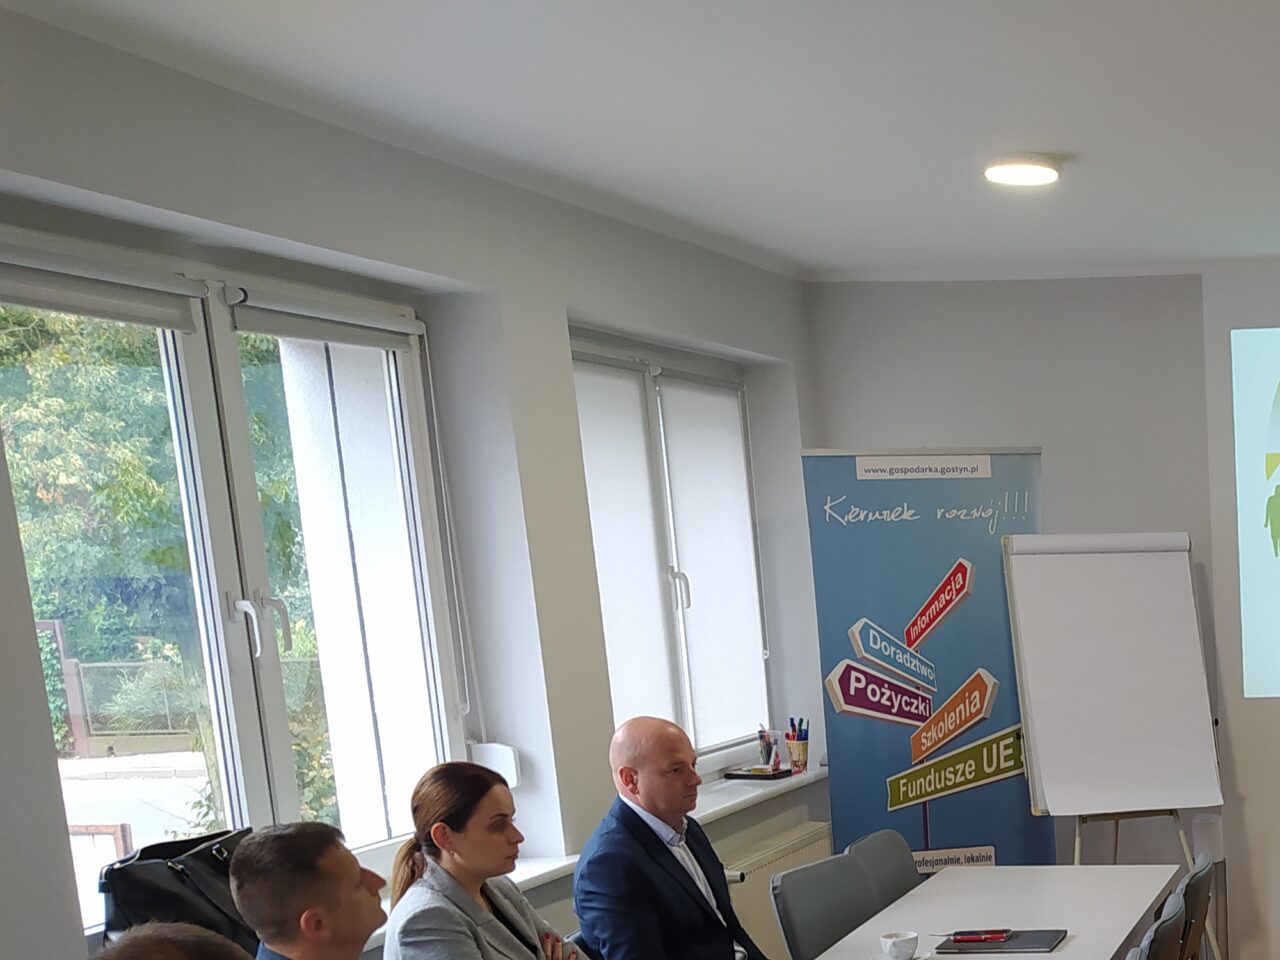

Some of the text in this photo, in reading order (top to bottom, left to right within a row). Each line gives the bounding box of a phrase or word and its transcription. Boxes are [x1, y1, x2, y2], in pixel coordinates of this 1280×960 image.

[863, 464, 979, 476] www.gospodarka.gostyn.pl
[823, 495, 921, 526] Kierunek
[910, 570, 964, 641] Informacja
[869, 628, 935, 681] Doradztwo
[850, 670, 930, 718] Pożyczki
[920, 688, 981, 751] Szkolenia
[899, 736, 1015, 801] Fundusze UE
[964, 853, 993, 864] lokalnie
